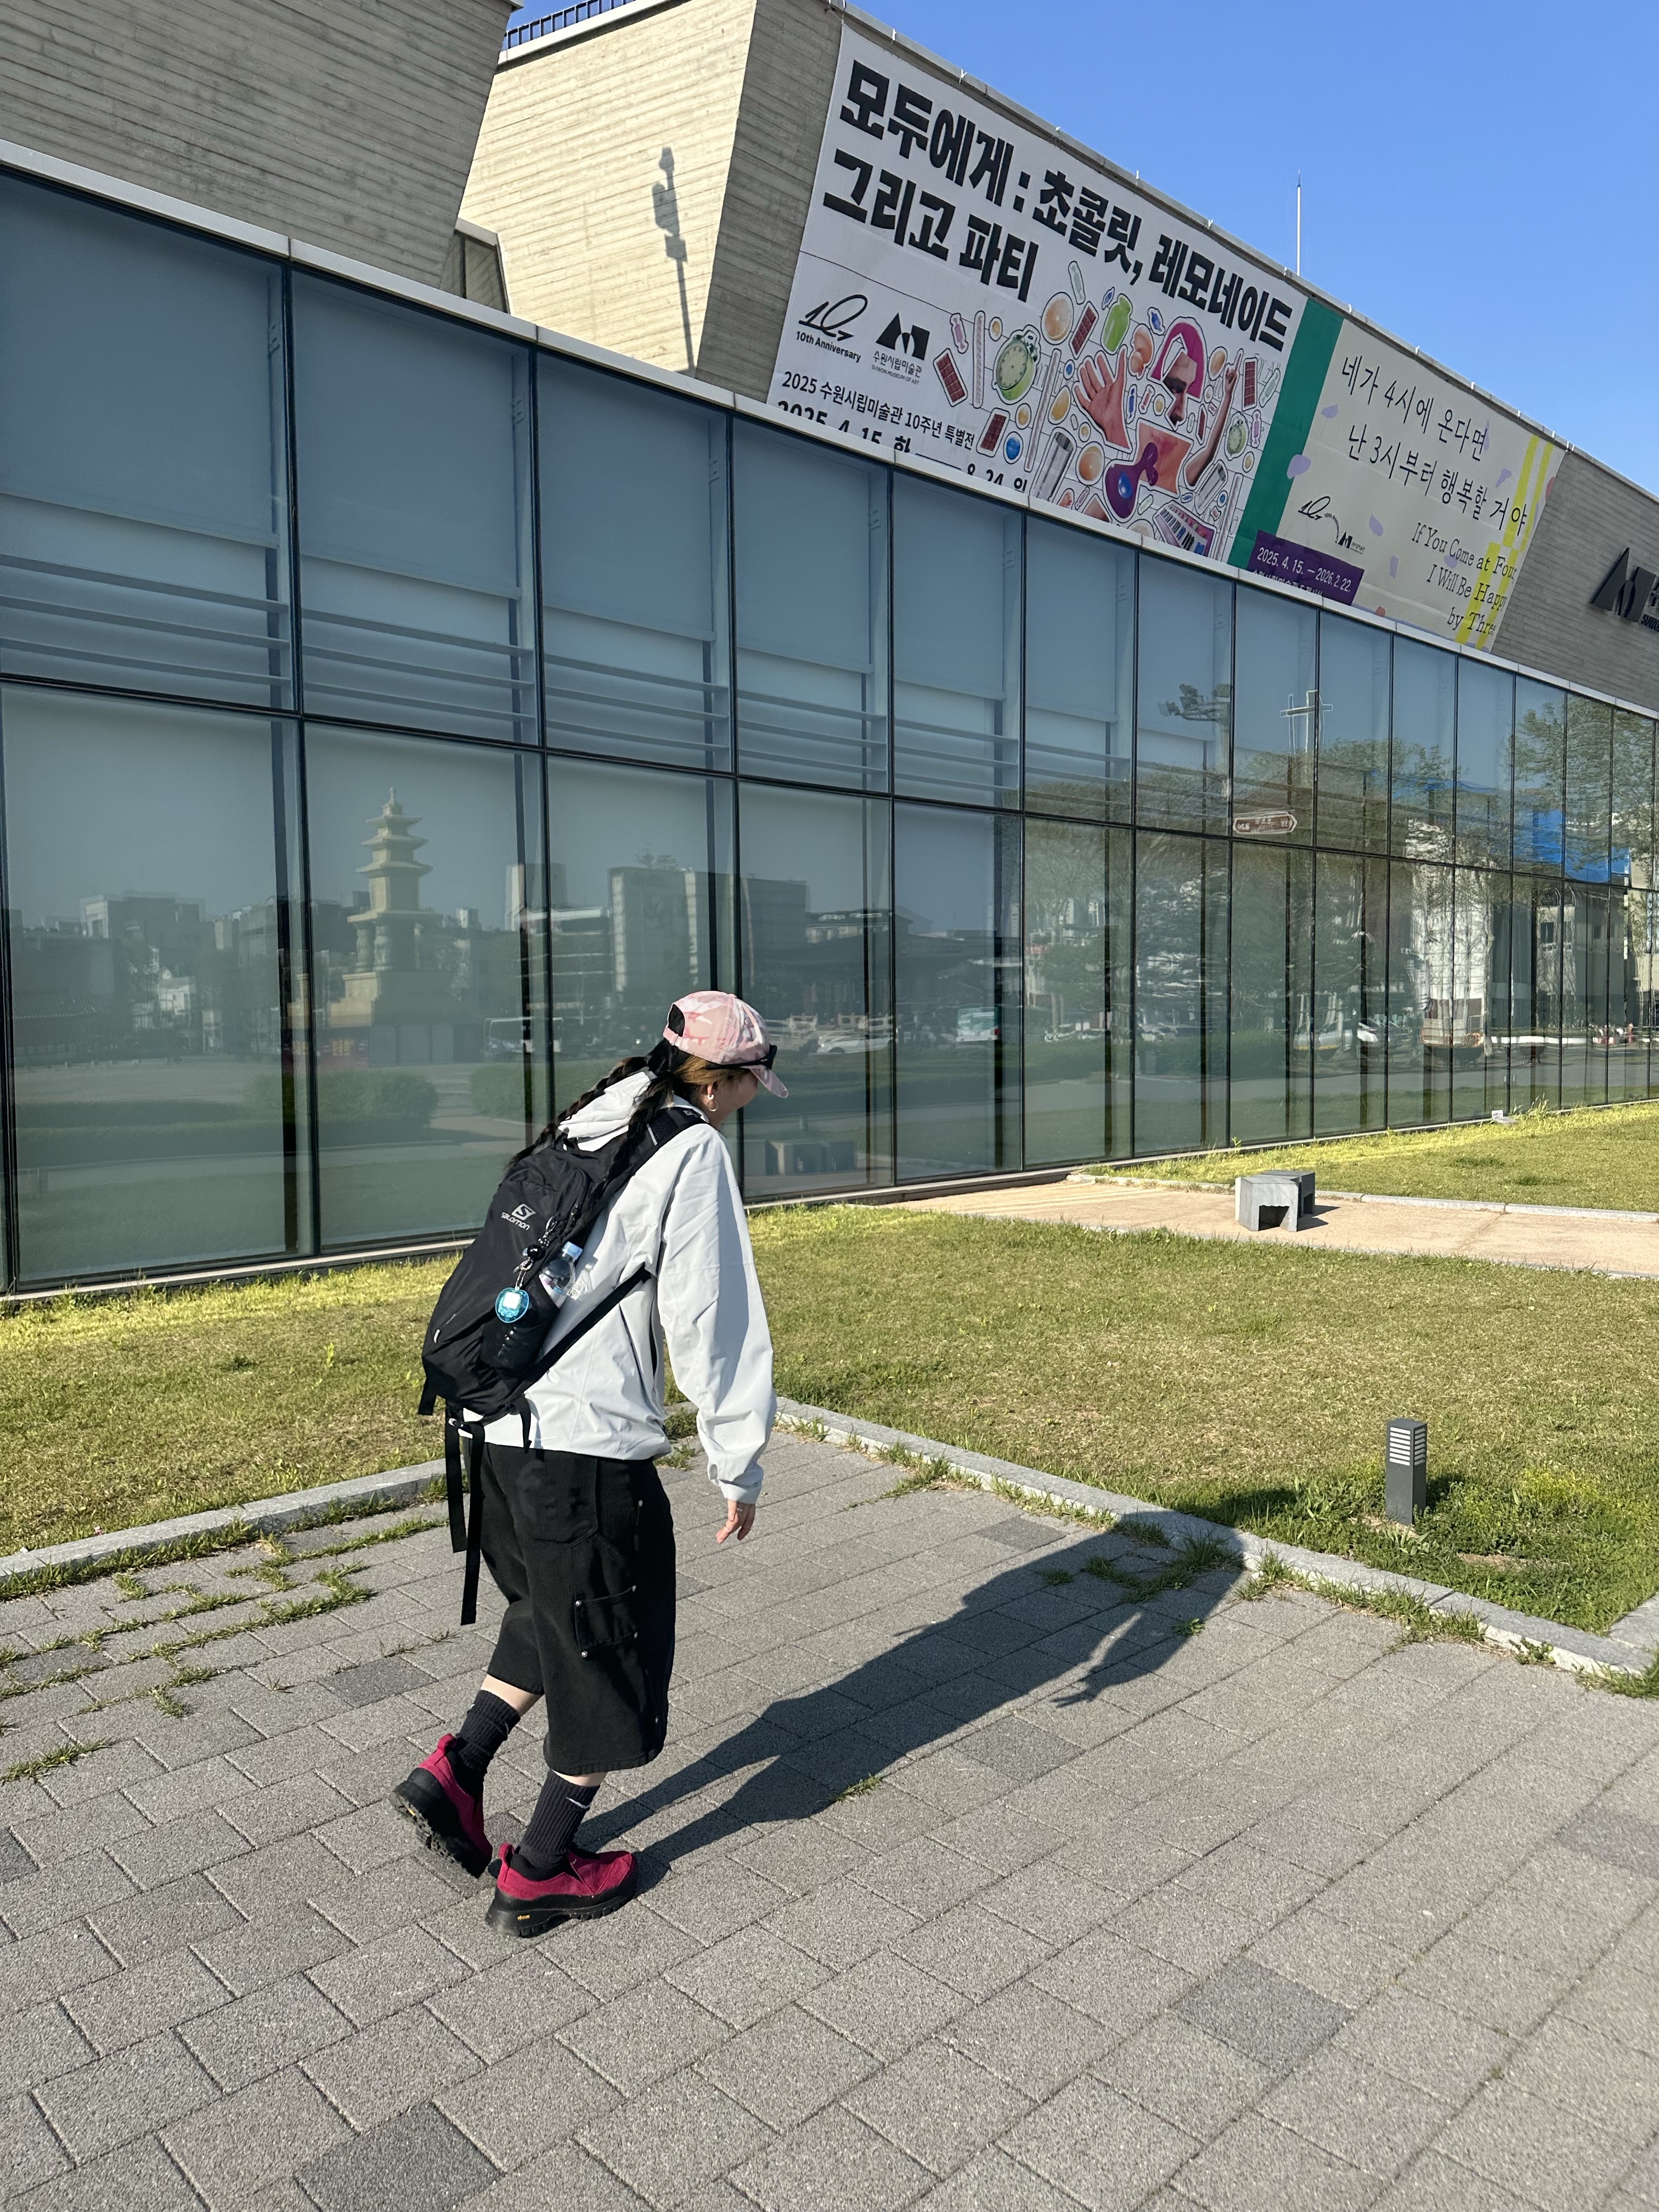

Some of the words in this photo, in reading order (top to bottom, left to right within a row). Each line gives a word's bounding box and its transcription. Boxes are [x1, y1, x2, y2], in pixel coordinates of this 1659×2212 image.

[823, 148, 956, 261] 그리고
[959, 213, 1039, 303] 파티
[1032, 169, 1143, 286] 초콜릿,
[1148, 234, 1293, 352] 레모네이드
[796, 331, 814, 345] 10th
[815, 337, 861, 363] Anniversary
[873, 351, 923, 378] 수원시립미술관
[871, 364, 887, 374] SUWON
[887, 369, 906, 380] MUSEUM
[782, 371, 818, 394] 2025
[820, 381, 903, 425] 수원시립미술관
[905, 412, 942, 439] 10주년
[945, 425, 975, 450] 특별전
[1342, 356, 1380, 405] 네가
[1384, 380, 1434, 433] 4시에
[1438, 409, 1487, 461] 온다면
[1348, 424, 1367, 460] 난
[1370, 436, 1437, 496] 3시부터
[1441, 469, 1488, 521] 행복할
[1489, 497, 1527, 537] 거야
[1257, 547, 1279, 567] 2025.
[1282, 556, 1289, 569] 4.
[1292, 559, 1304, 574] 15.
[1412, 522, 1426, 543] If
[1424, 527, 1448, 553] You
[1449, 538, 1475, 566] Come
[1476, 556, 1491, 571] at
[1426, 563, 1437, 582] I
[1438, 567, 1459, 592] Will
[1456, 577, 1472, 597] Be
[1447, 606, 1464, 630] by
[1467, 611, 1496, 636] Three
